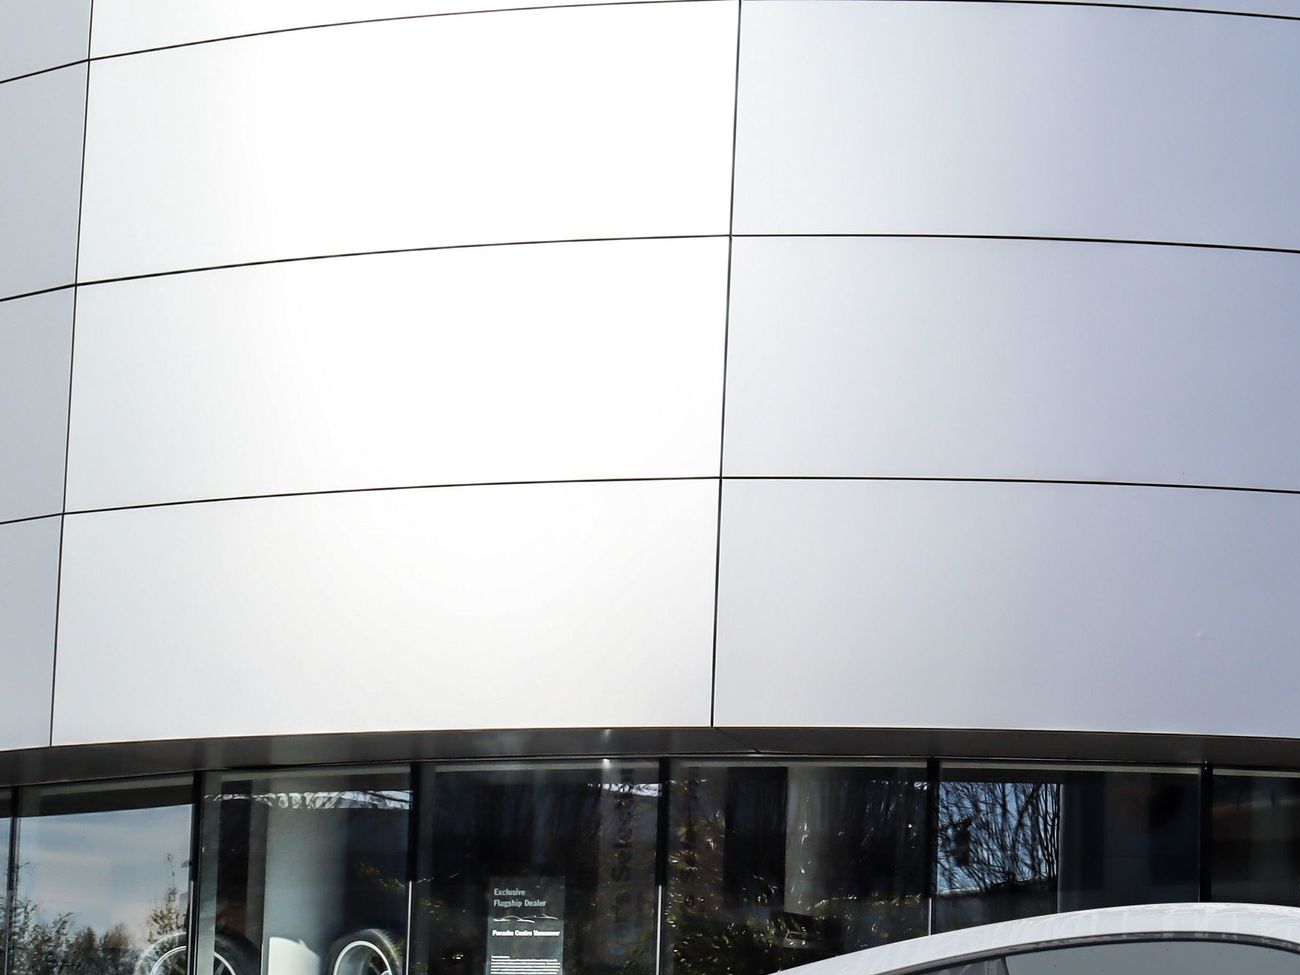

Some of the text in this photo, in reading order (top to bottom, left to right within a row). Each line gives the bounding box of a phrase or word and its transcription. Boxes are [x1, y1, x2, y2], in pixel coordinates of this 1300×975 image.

[493, 888, 526, 896] Exclusive
[493, 899, 546, 908] Flagship Dealer
